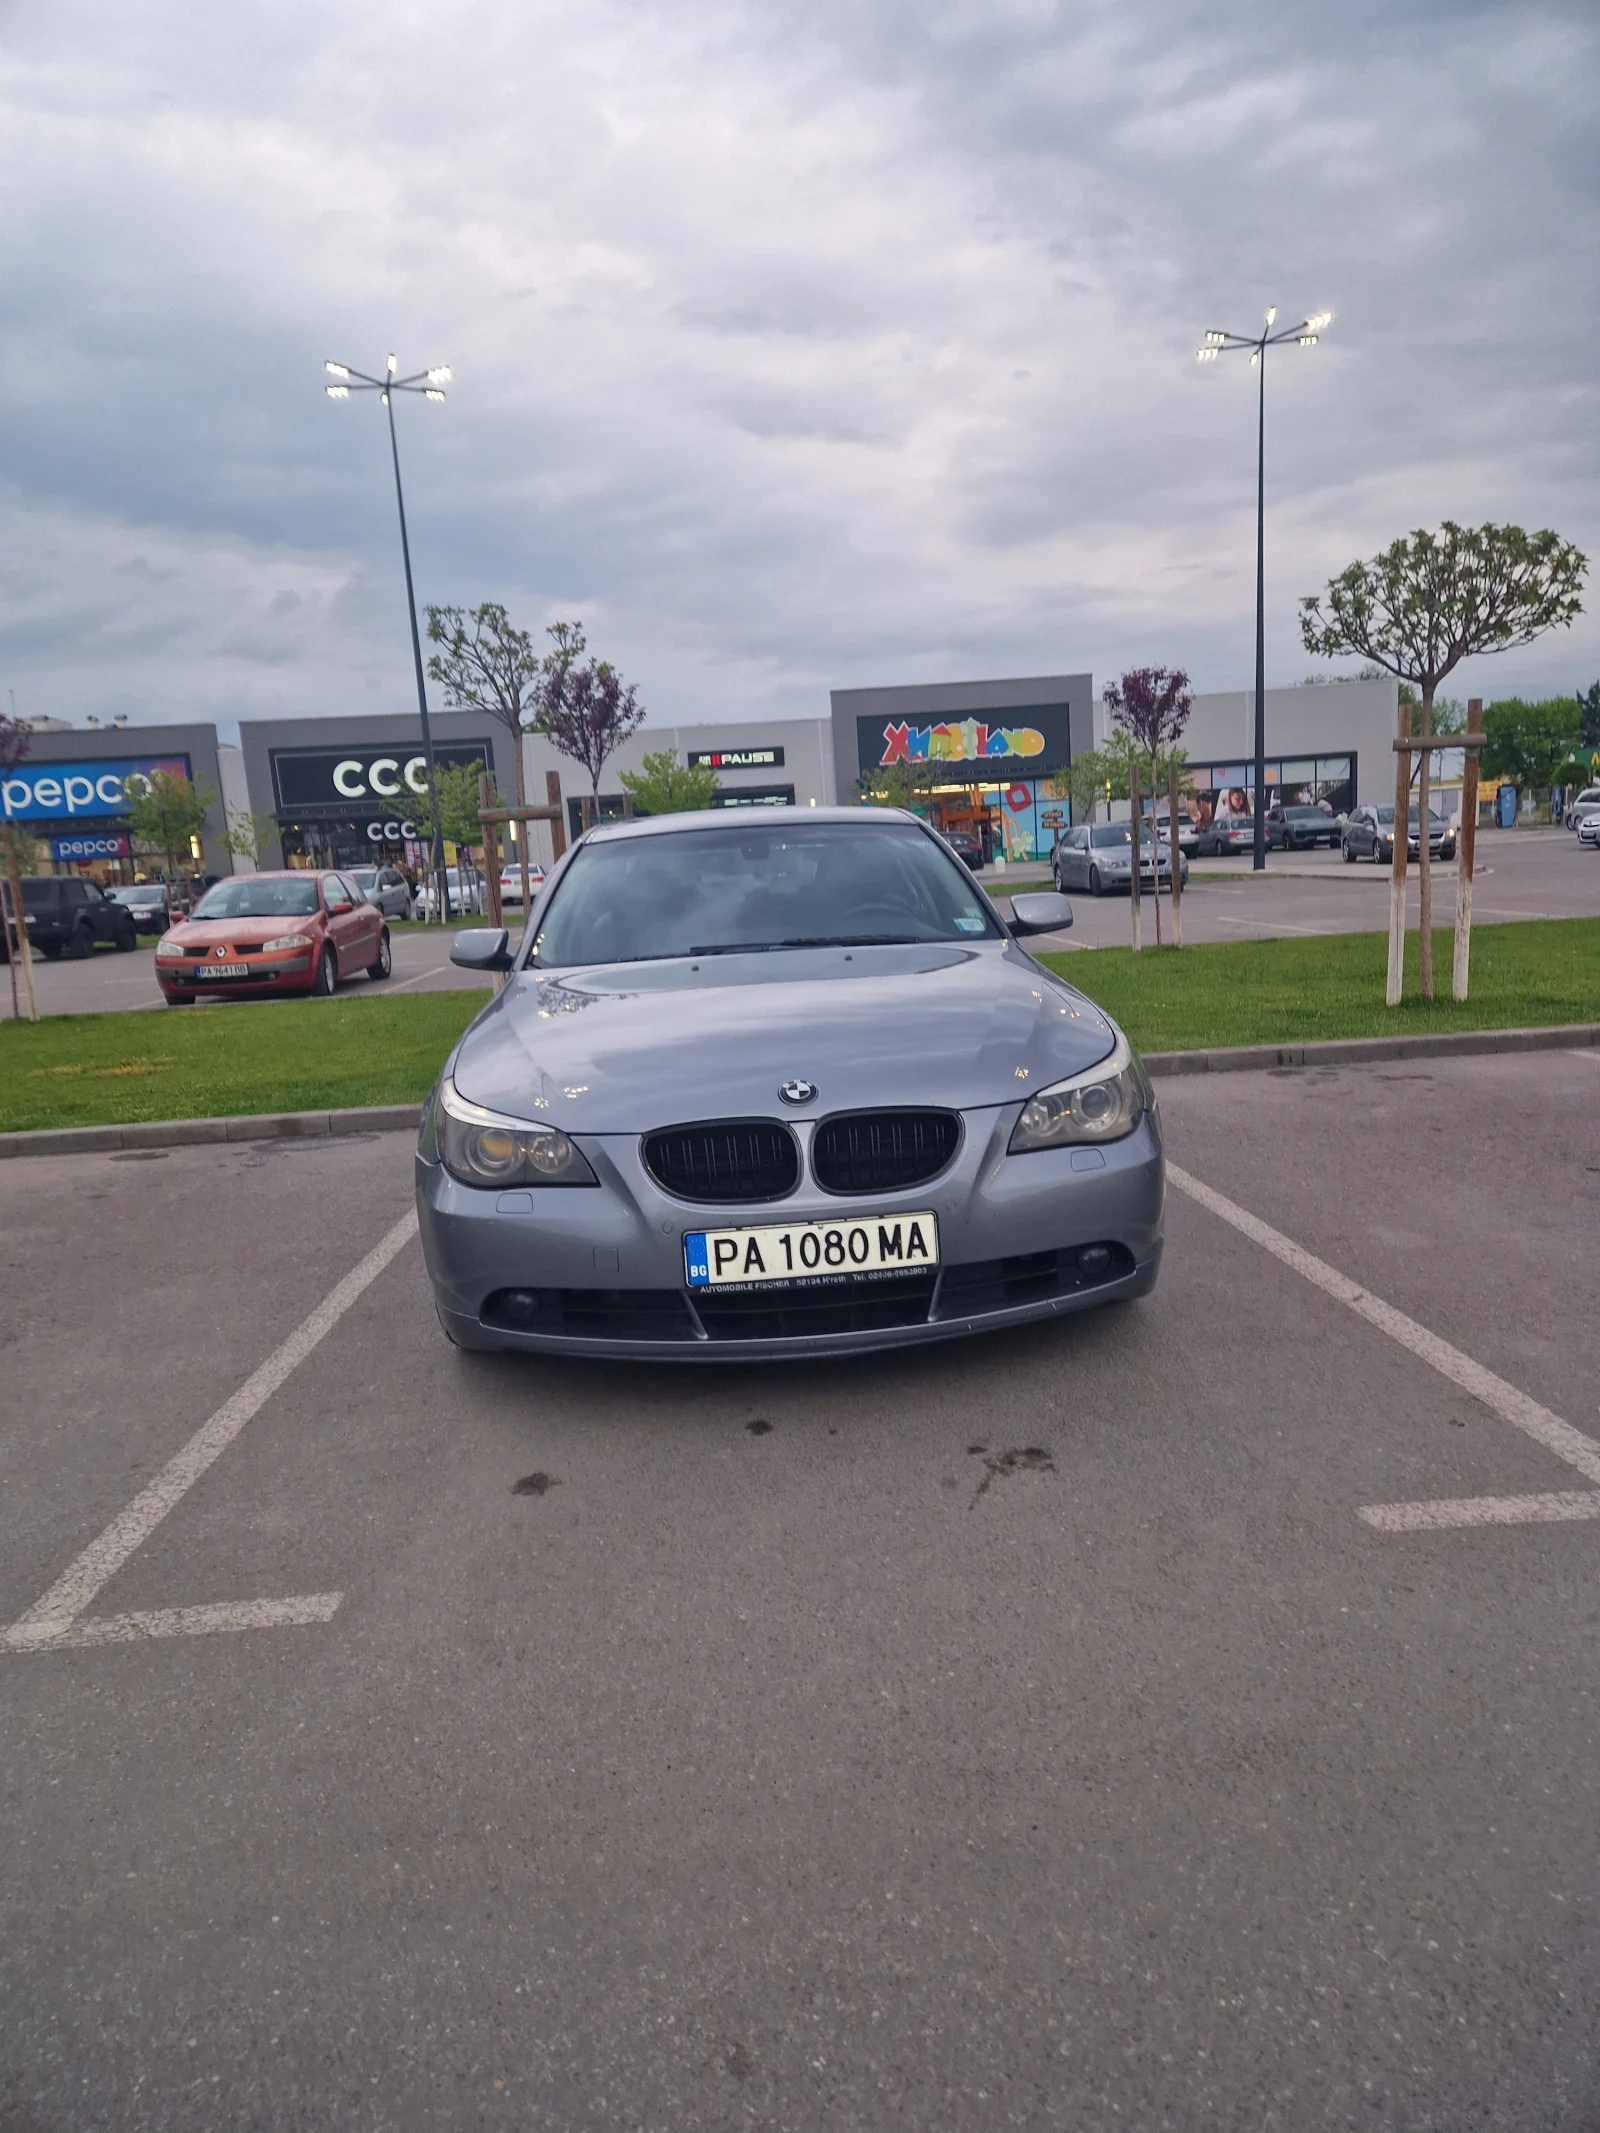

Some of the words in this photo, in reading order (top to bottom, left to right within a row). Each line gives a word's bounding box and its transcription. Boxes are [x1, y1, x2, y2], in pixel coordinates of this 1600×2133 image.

[332, 756, 429, 798] CCC
[1, 772, 153, 816] pepco
[366, 821, 417, 841] CCC
[58, 838, 118, 857] pepco
[714, 1236, 766, 1276] PA
[779, 1227, 869, 1271] 1080
[878, 1221, 929, 1262] MA
[690, 1265, 707, 1277] BG
[700, 1283, 753, 1294] AUTOMOBILE
[755, 1280, 790, 1290] FISCHER
